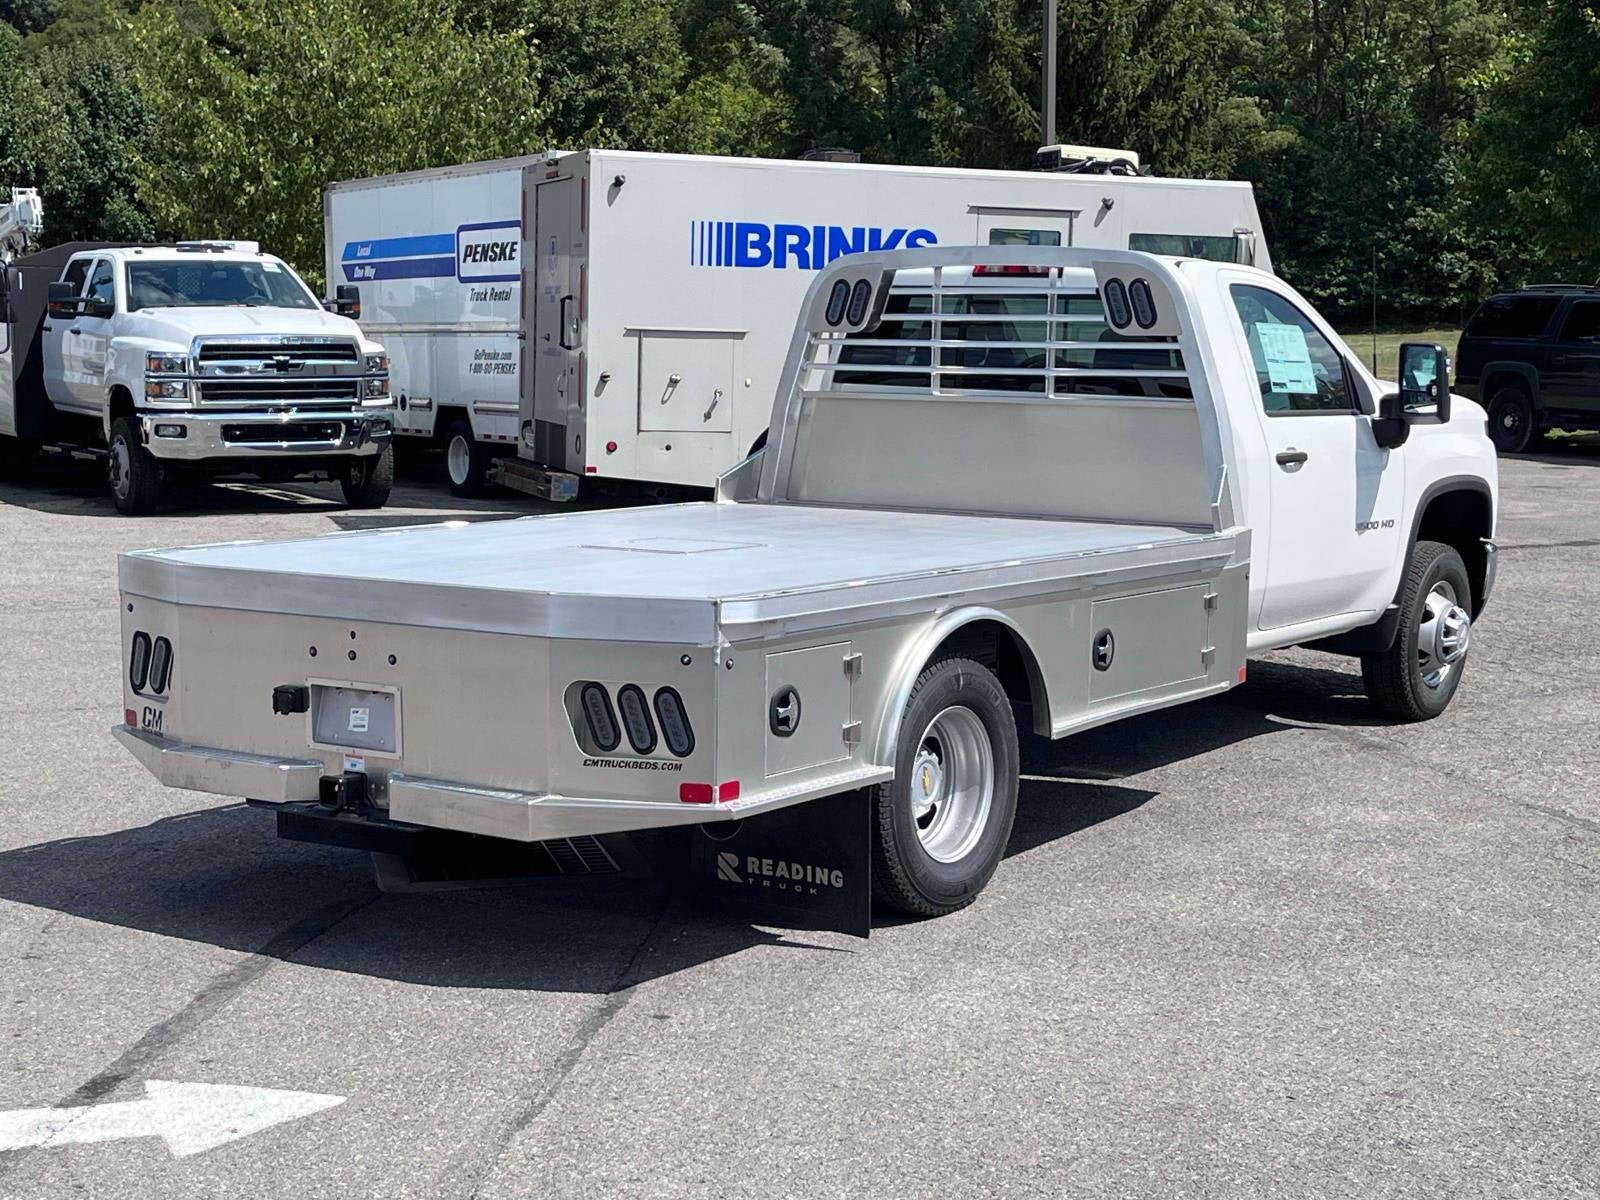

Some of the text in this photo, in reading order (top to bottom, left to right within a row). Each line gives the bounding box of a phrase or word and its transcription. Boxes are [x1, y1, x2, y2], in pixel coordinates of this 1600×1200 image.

[356, 243, 372, 257] Local
[462, 241, 518, 264] PENSKE
[353, 265, 377, 280] One Way
[469, 287, 512, 302] Truck Rental
[142, 705, 163, 731] CM
[582, 758, 683, 772] CMTRUCKBEDS.COM
[746, 855, 844, 889] READING
[747, 877, 818, 896] TRUCK
